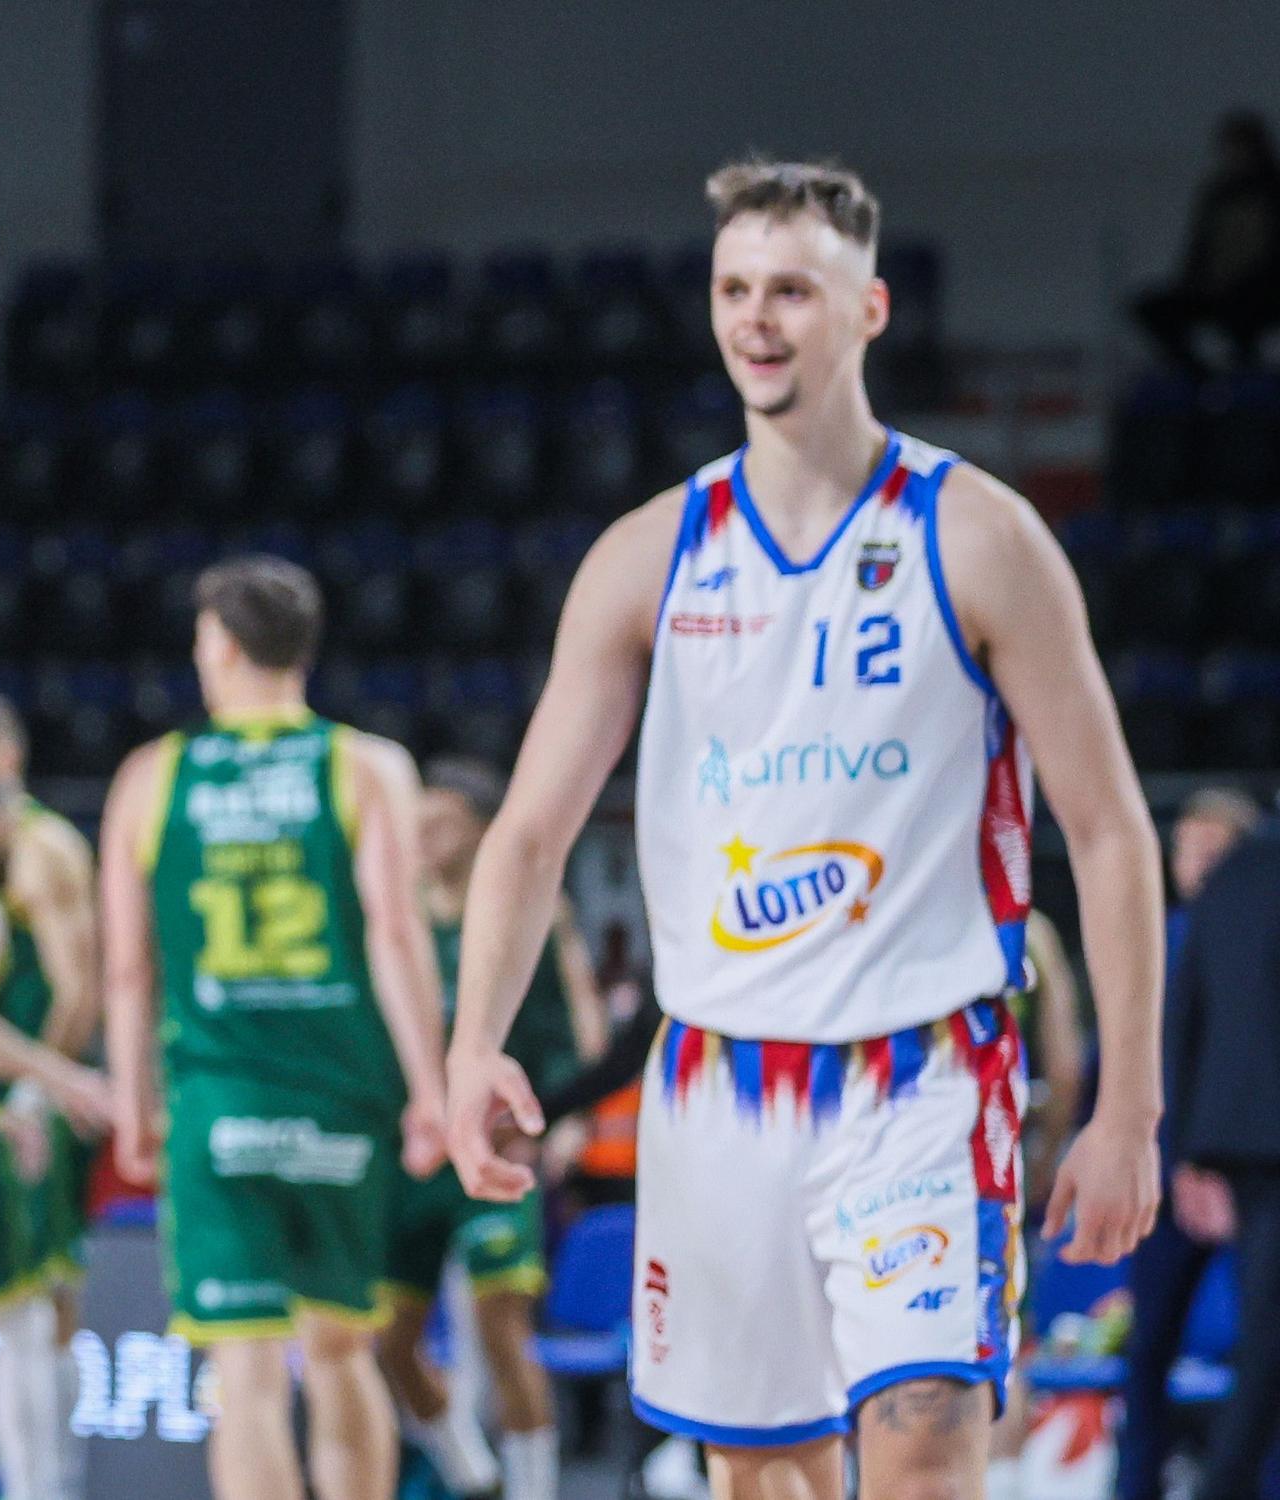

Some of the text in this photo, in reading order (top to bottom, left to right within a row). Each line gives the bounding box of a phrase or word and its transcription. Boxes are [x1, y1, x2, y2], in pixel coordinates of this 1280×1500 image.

[813, 612, 903, 687] 12
[742, 731, 910, 788] arriva
[189, 877, 332, 980] 12
[736, 859, 846, 931] LOTTO
